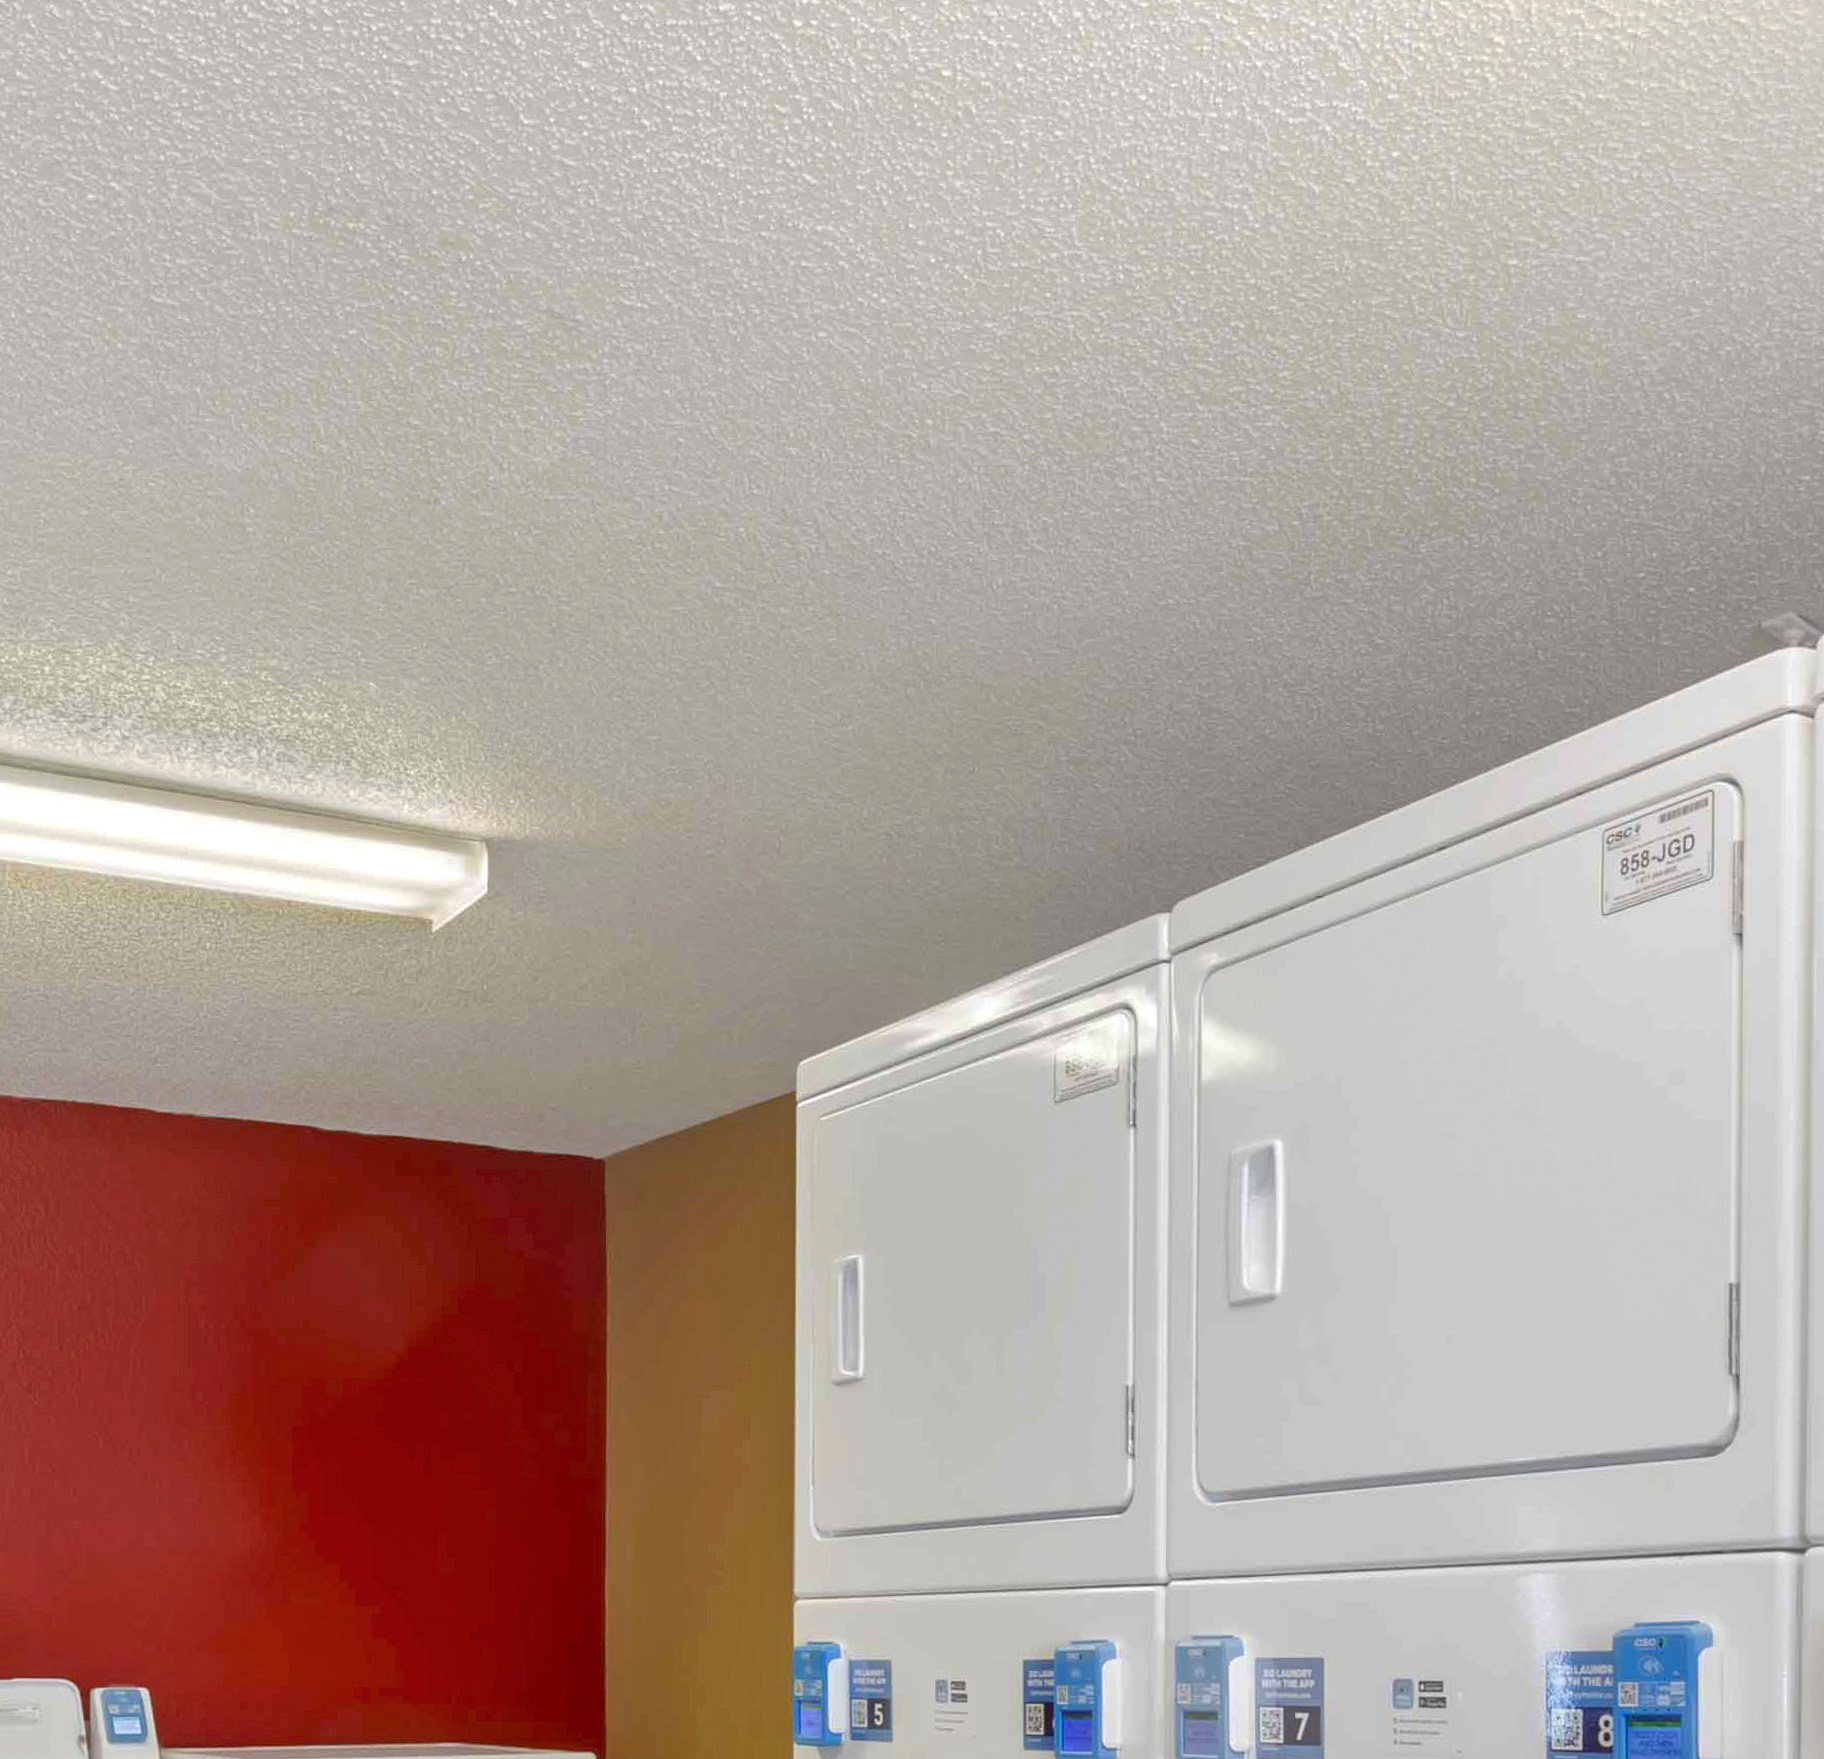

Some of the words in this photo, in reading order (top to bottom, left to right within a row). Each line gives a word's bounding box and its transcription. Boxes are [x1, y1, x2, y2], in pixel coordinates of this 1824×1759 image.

[1620, 834, 1695, 875] 858-JGD
[874, 1702, 884, 1726] 5
[1294, 1712, 1310, 1741] 7
[1598, 1714, 1614, 1748] 8
